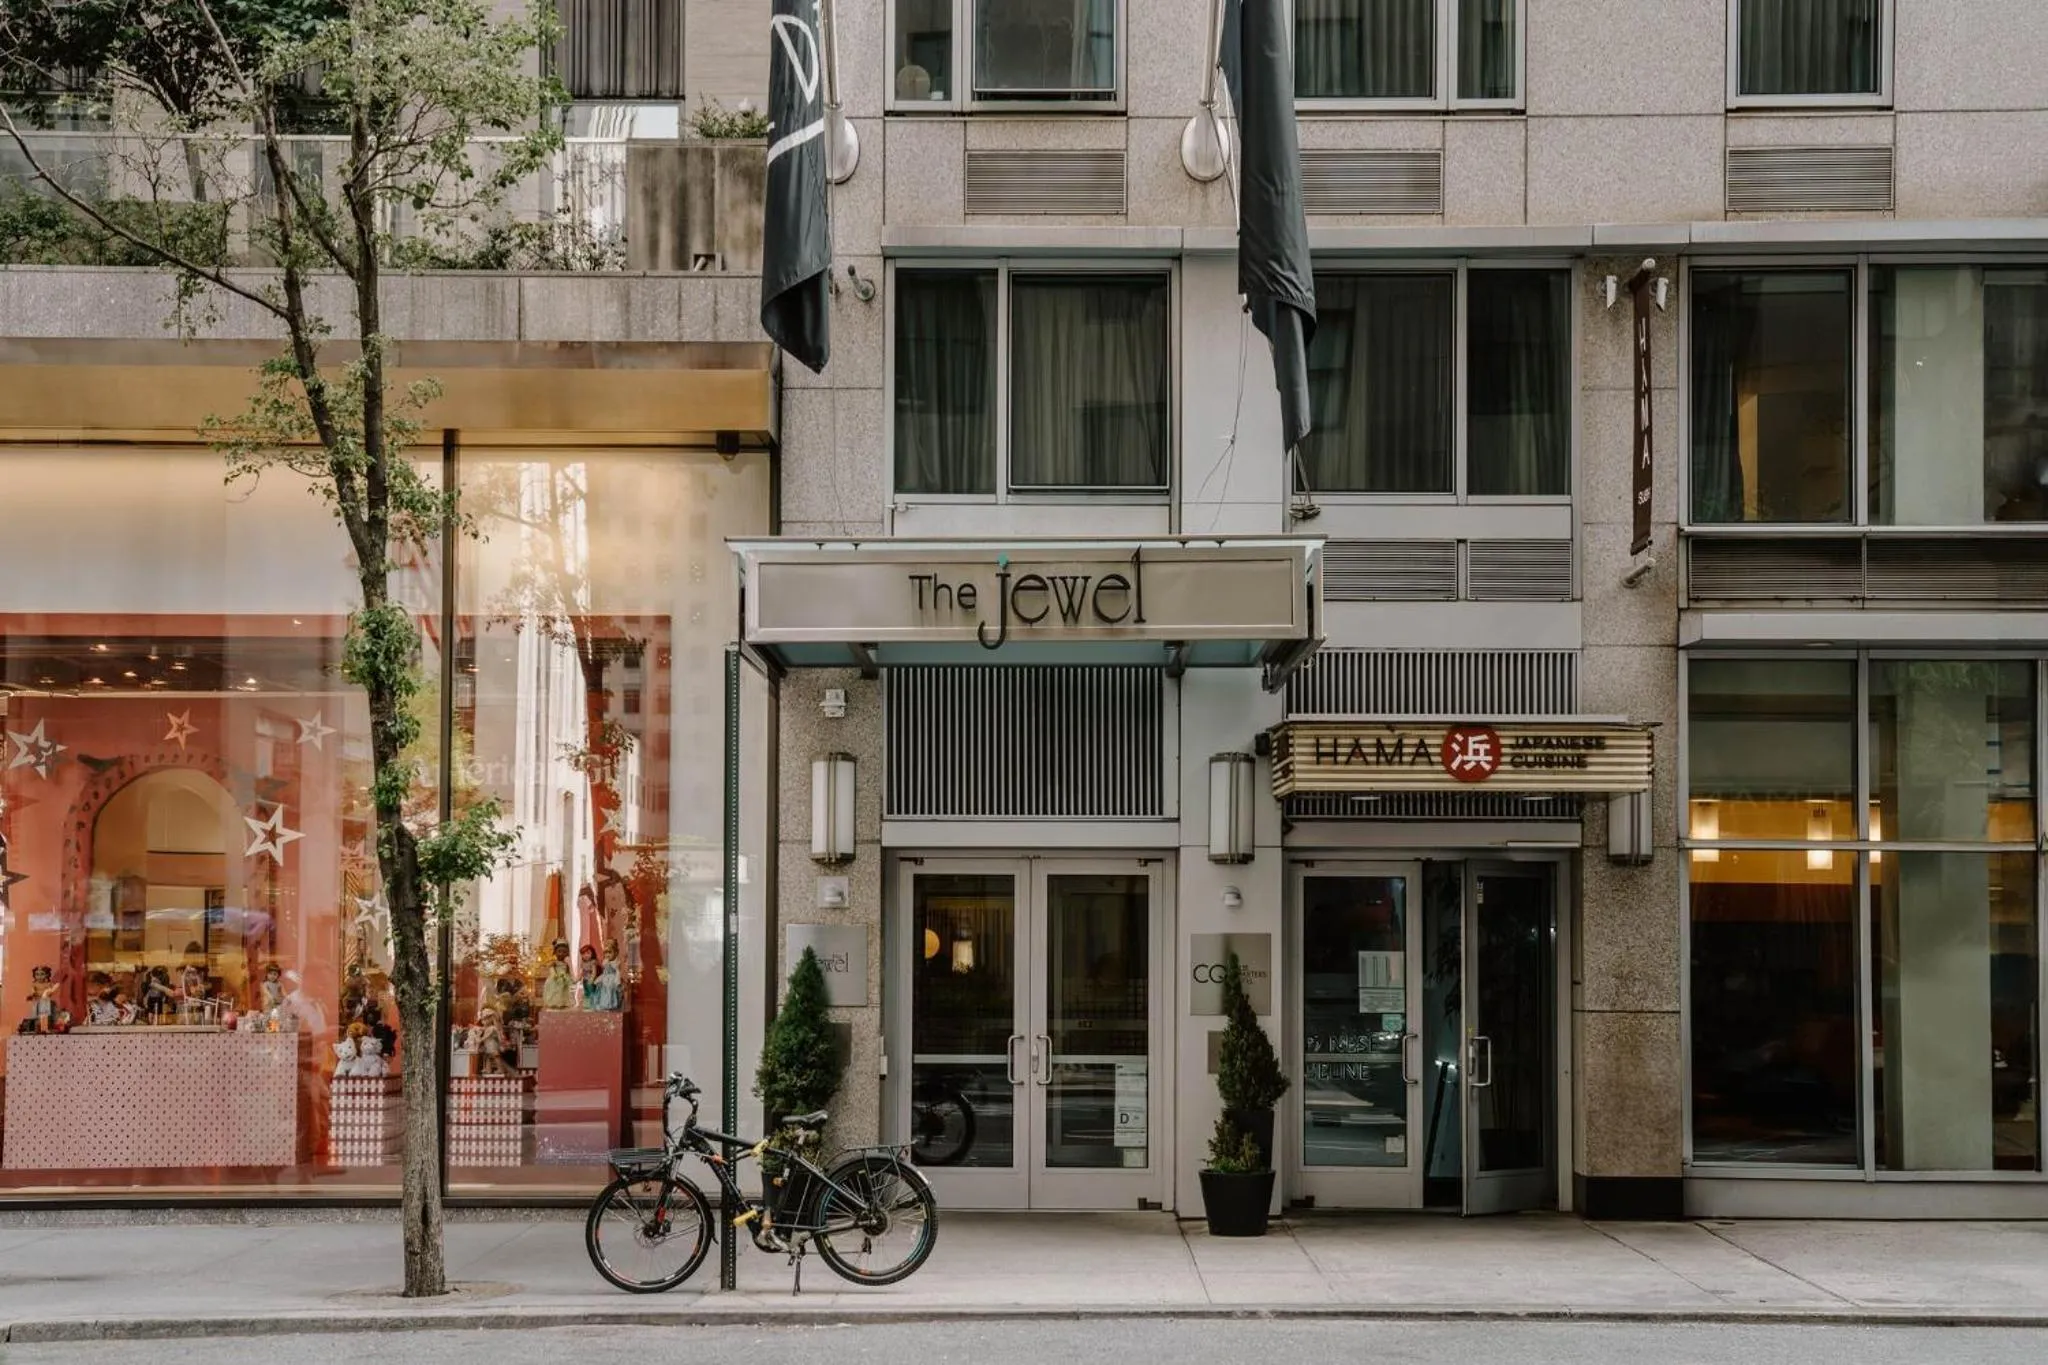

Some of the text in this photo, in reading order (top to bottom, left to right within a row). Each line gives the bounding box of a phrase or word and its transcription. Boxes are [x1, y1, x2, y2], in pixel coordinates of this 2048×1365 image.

[1638, 317, 1650, 470] HAMA
[908, 544, 1147, 651] The jewel
[1313, 736, 1434, 766] HAMA
[1450, 732, 1494, 772] 浜
[1509, 736, 1606, 750] JAPANESE
[1510, 754, 1588, 769] CUISINE
